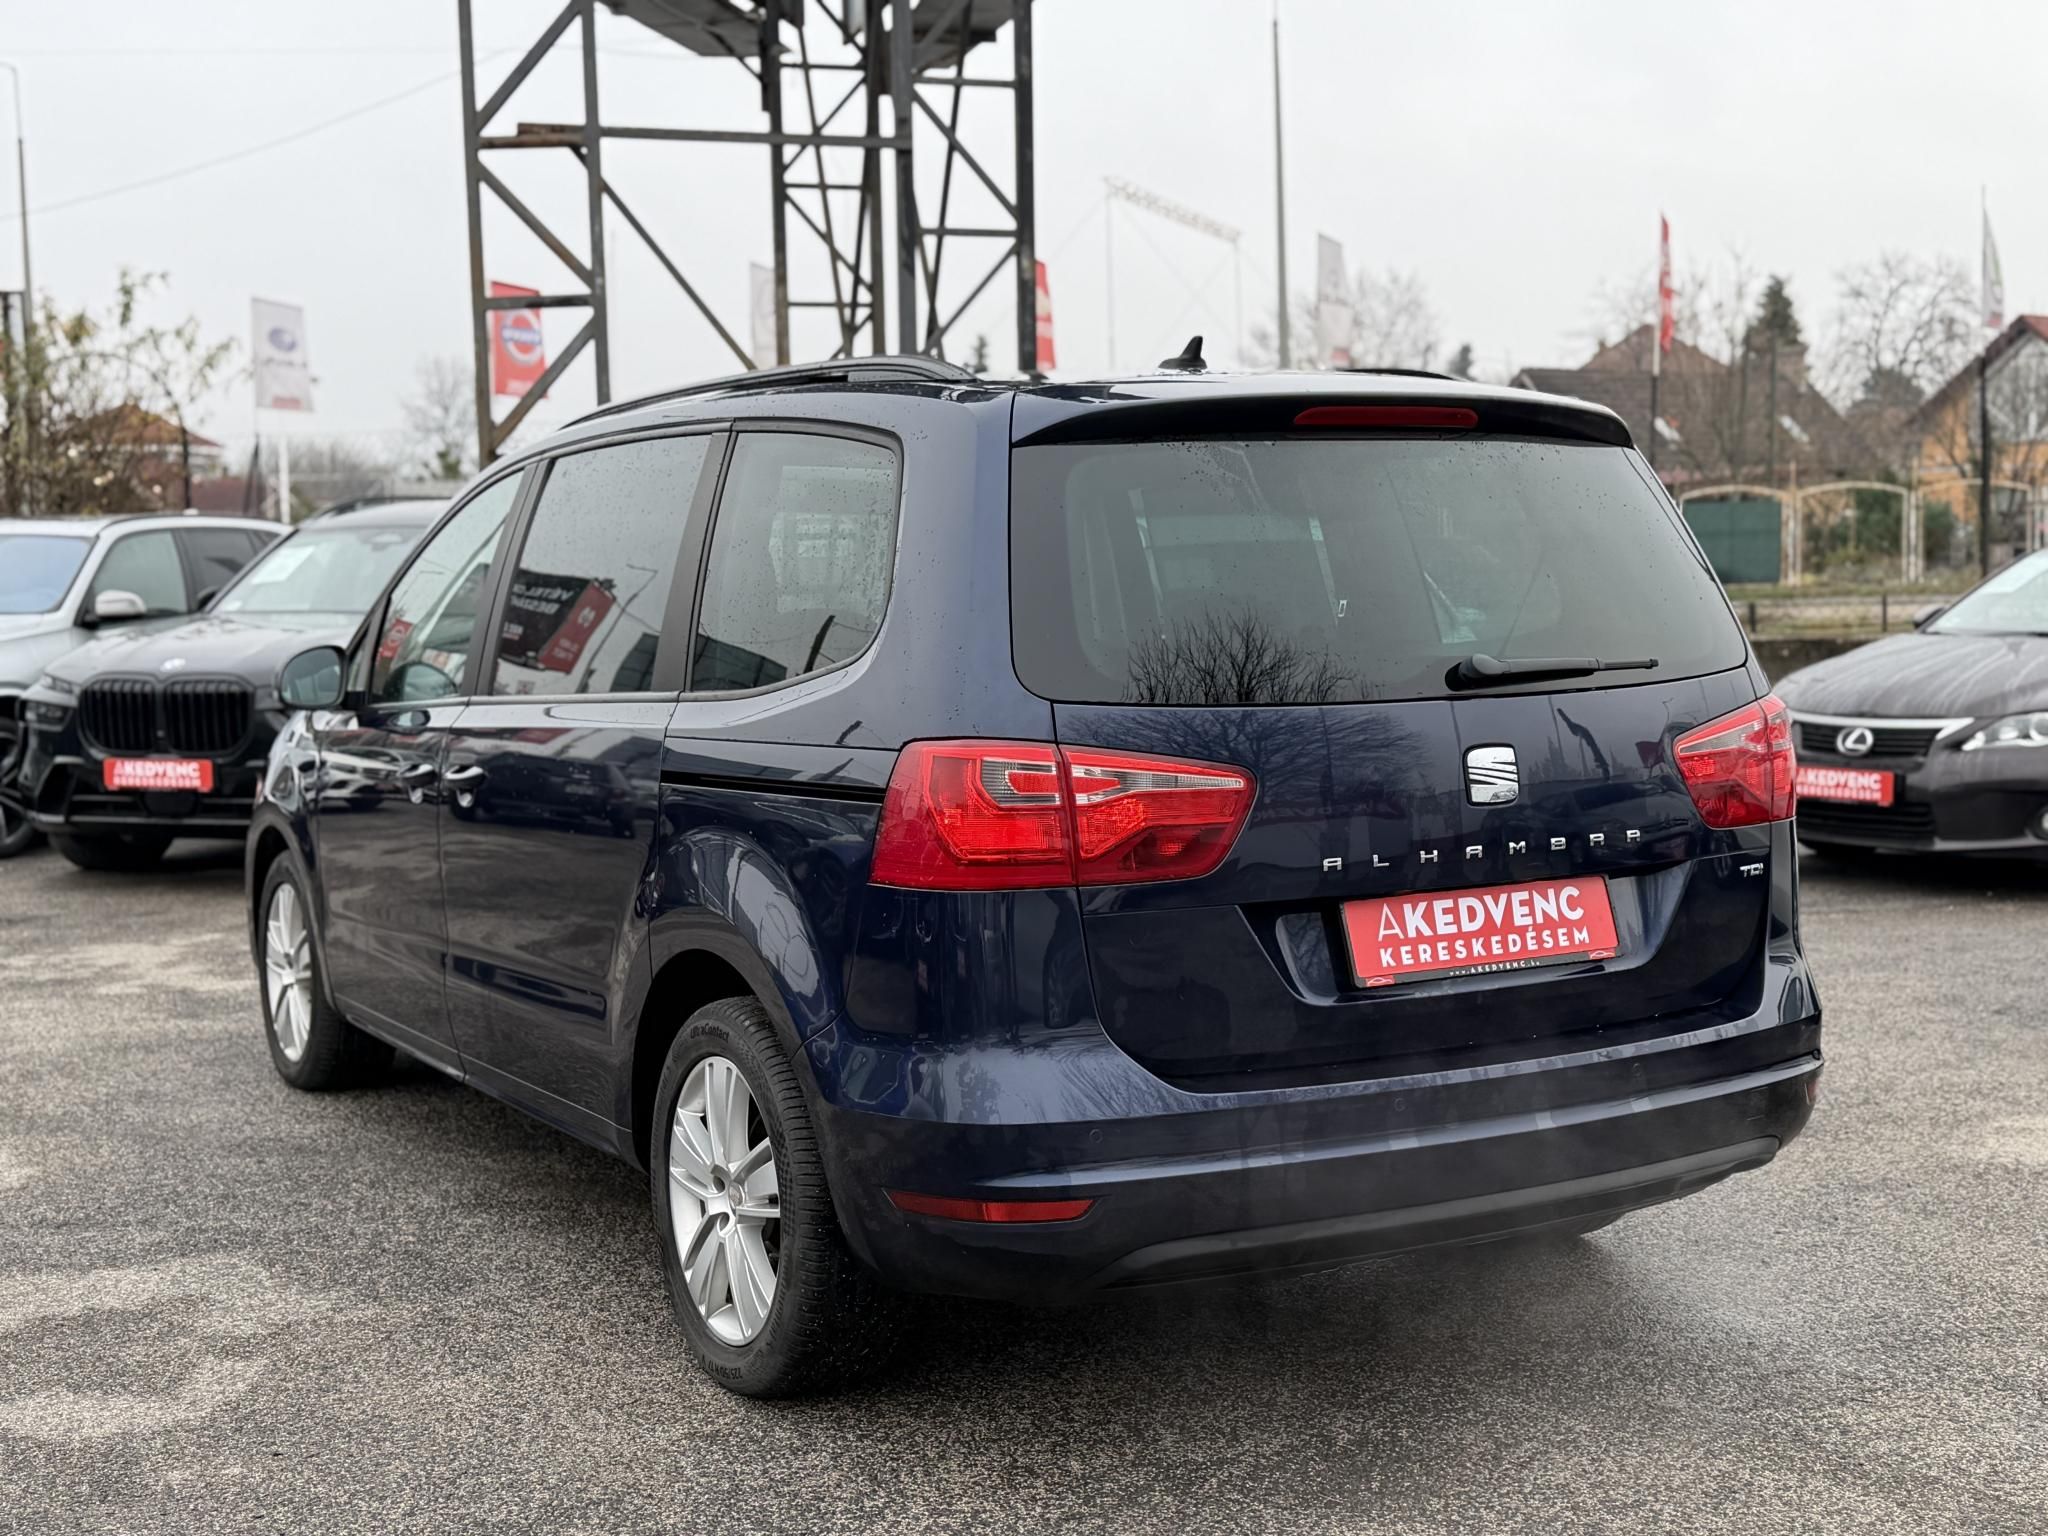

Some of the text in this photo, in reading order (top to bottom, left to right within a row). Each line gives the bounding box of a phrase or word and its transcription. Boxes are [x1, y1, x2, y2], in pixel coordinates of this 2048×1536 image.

[1322, 829, 1641, 872] ALHAMBRA
[1740, 862, 1764, 878] TDI
[1380, 926, 1590, 968] KERESKEDÉSEM
